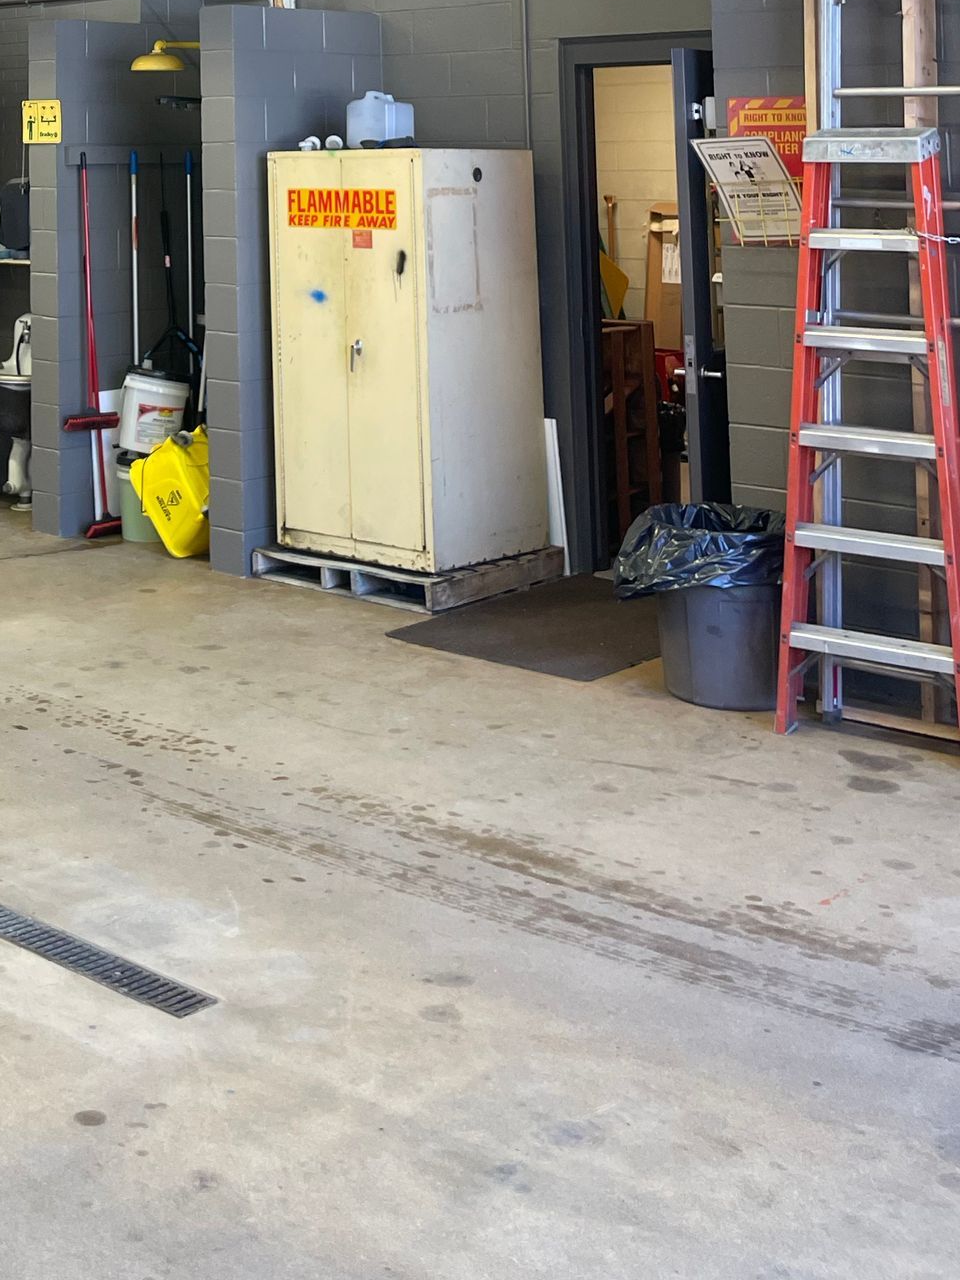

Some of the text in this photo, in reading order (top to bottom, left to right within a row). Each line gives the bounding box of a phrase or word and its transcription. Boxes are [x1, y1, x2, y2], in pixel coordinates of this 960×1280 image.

[744, 113, 768, 122] RIGHT
[772, 113, 783, 122] TO
[744, 131, 806, 142] COMPLIANC
[708, 152, 732, 160] RIGHT
[288, 190, 395, 214] FLAMMABLE
[289, 215, 396, 228] KEEP FIRE AWAY
